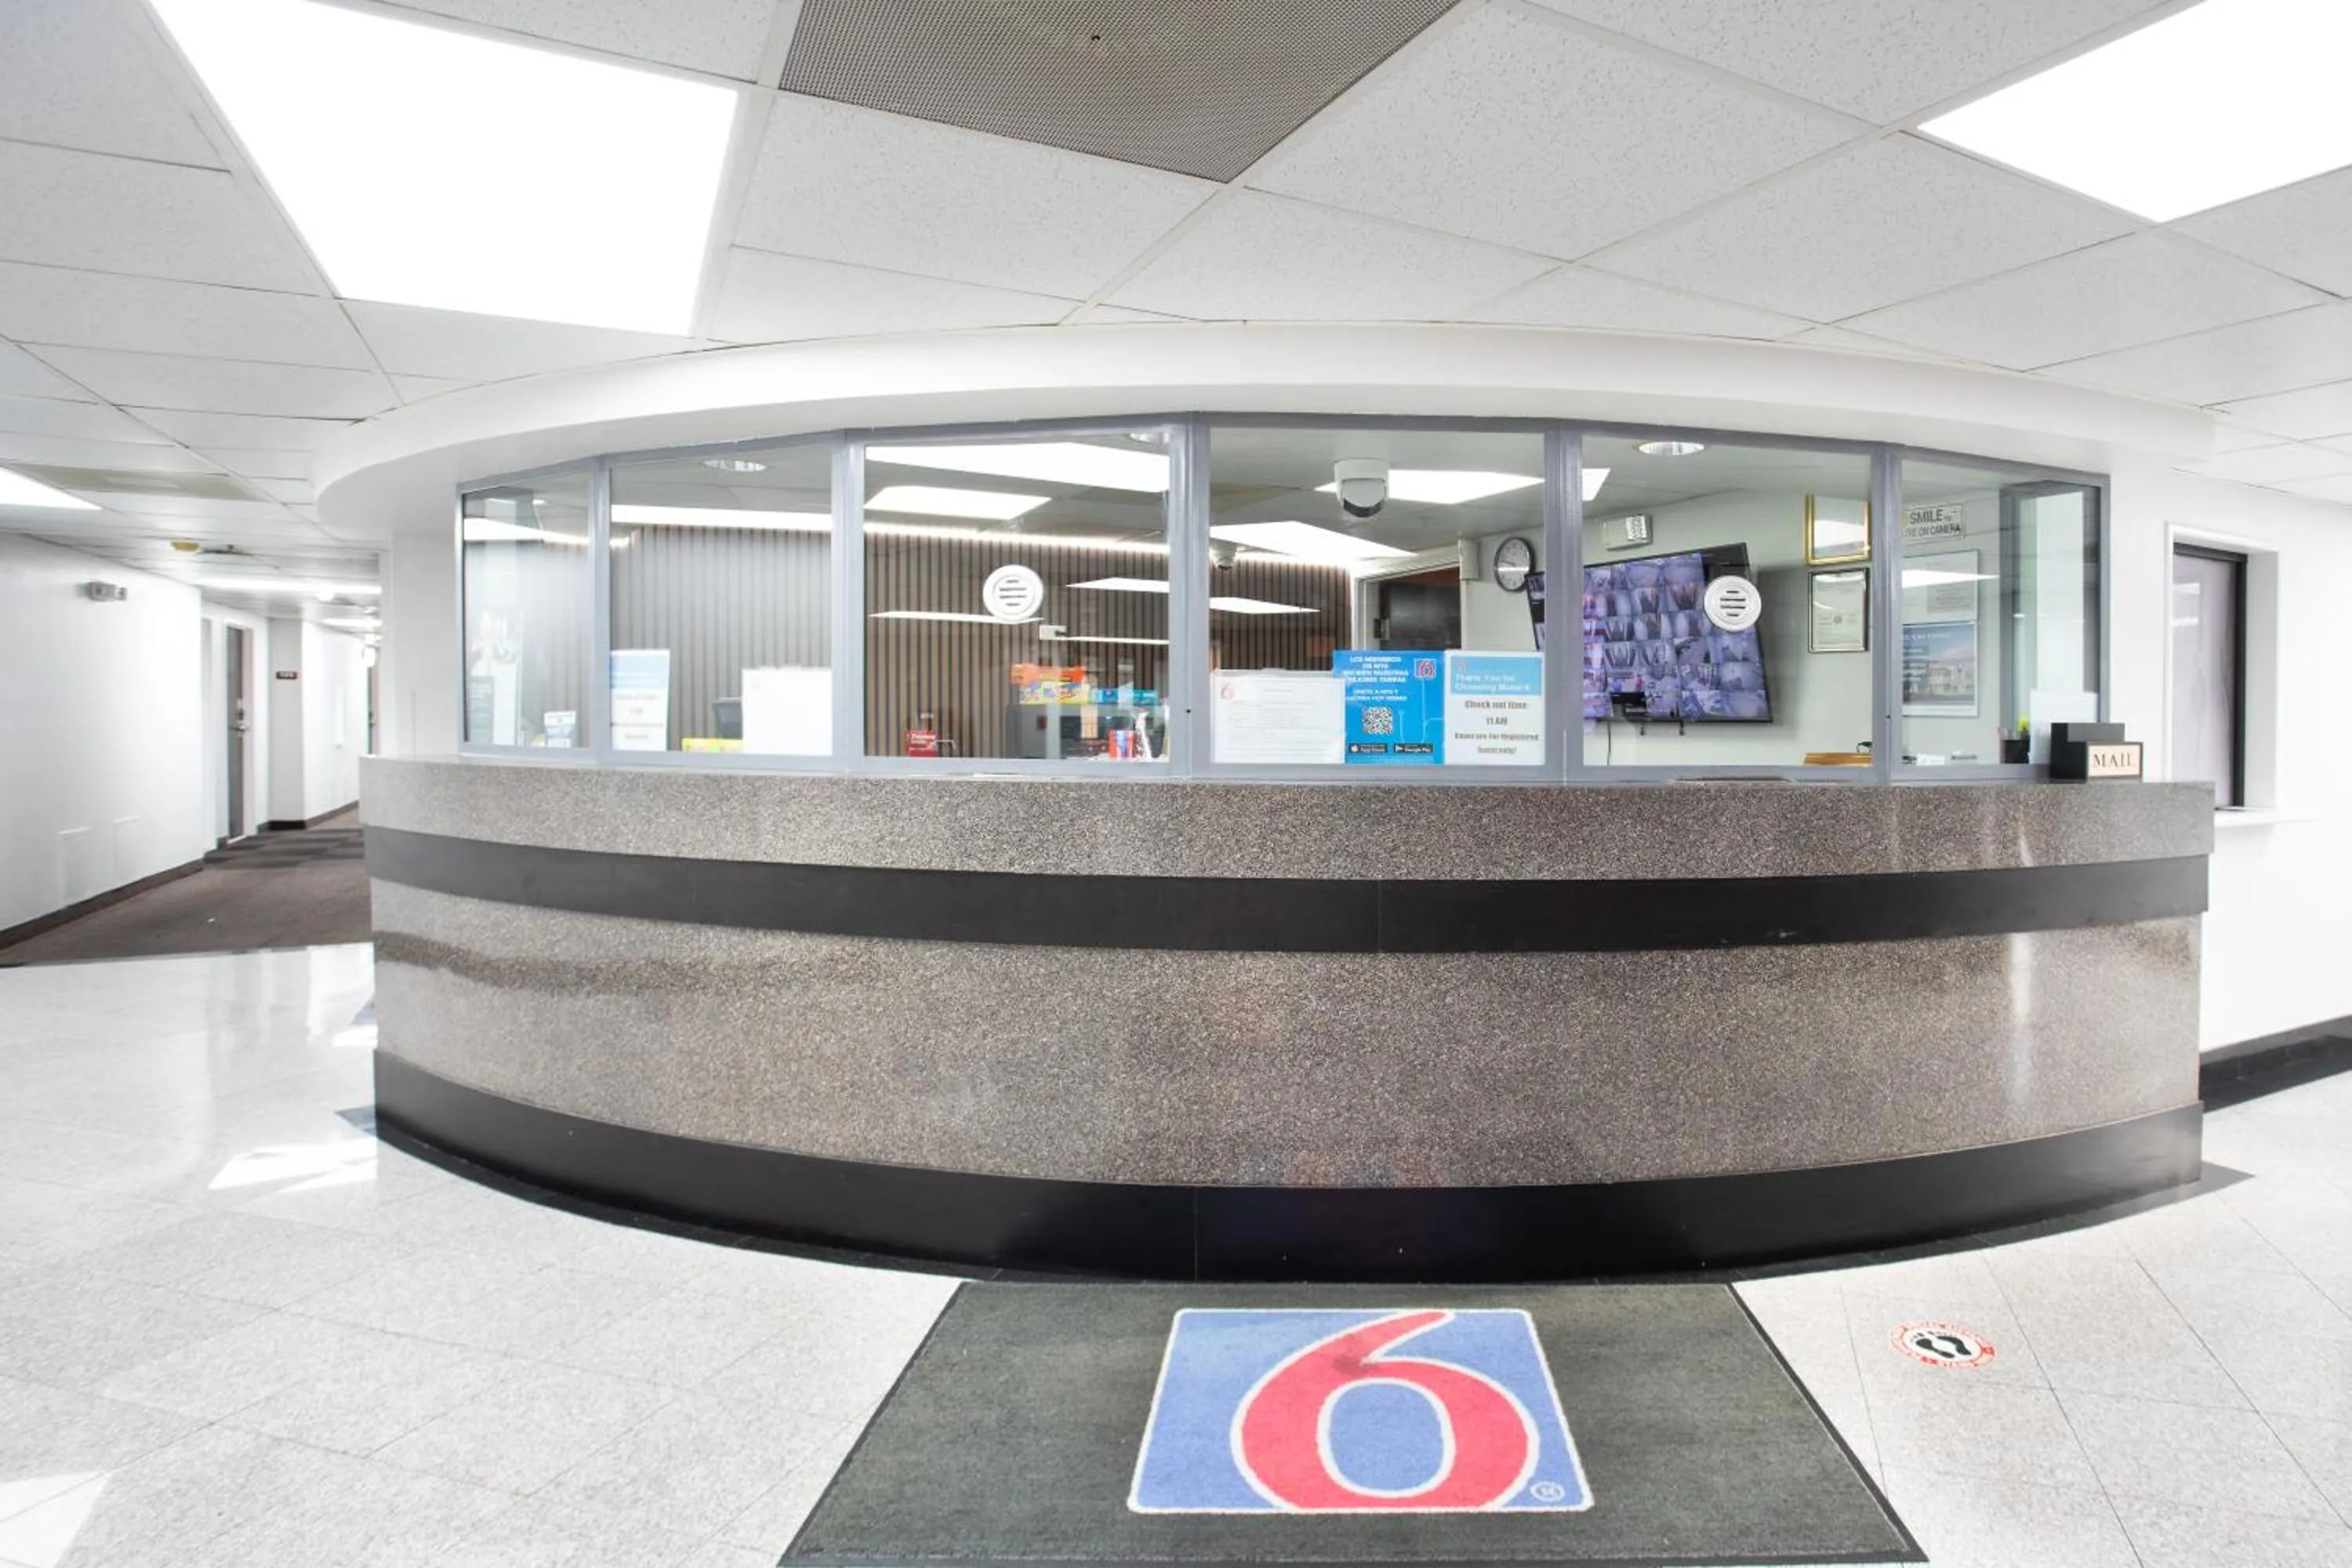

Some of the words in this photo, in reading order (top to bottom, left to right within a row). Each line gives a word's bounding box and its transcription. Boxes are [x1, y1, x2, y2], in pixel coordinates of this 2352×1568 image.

[1909, 509, 1944, 524] SMILE
[1918, 526, 1929, 537] ON
[1930, 522, 1961, 535] CAMERA
[2094, 752, 2136, 768] MAIL
[1229, 1308, 1540, 1511] 6
